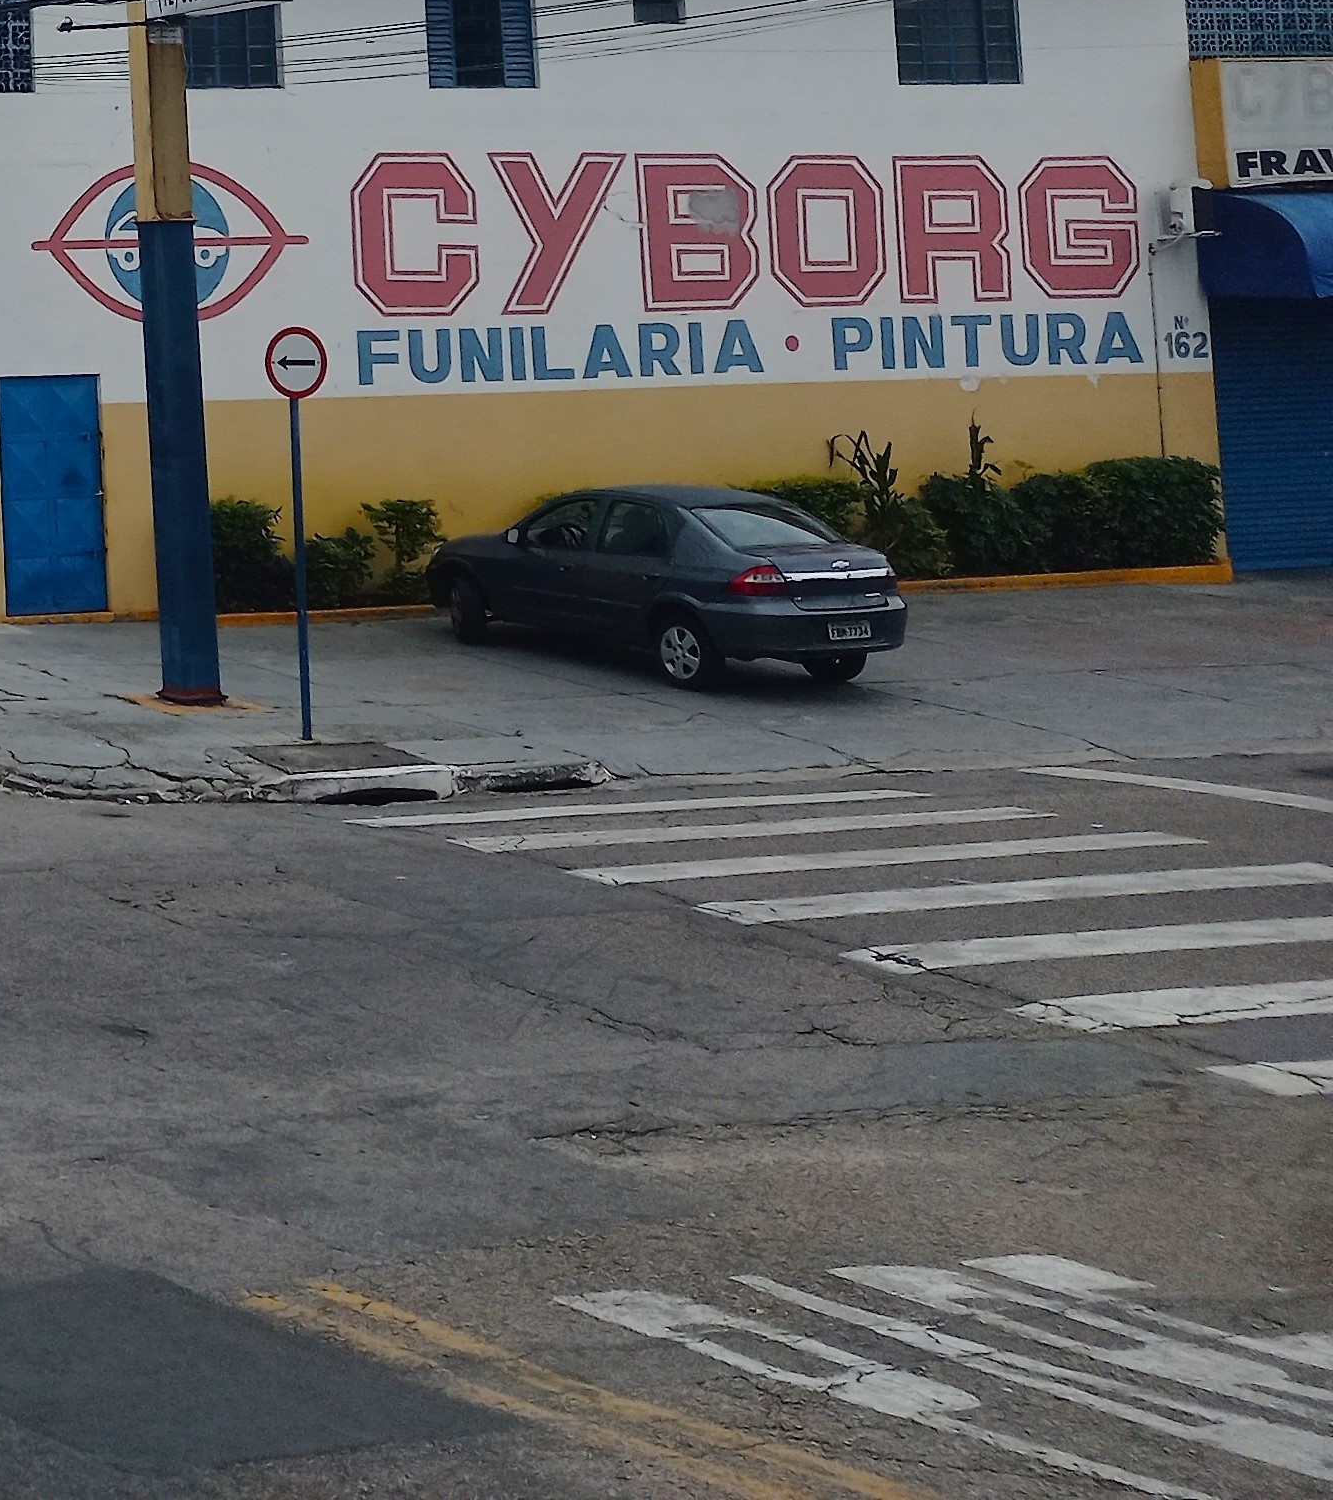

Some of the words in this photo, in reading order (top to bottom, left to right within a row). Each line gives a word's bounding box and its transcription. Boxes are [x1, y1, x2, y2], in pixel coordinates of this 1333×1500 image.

[351, 150, 1140, 316] CYBORG
[356, 319, 764, 386] FUNILARIA
[829, 311, 1144, 371] PINTURA
[1164, 331, 1209, 358] 162
